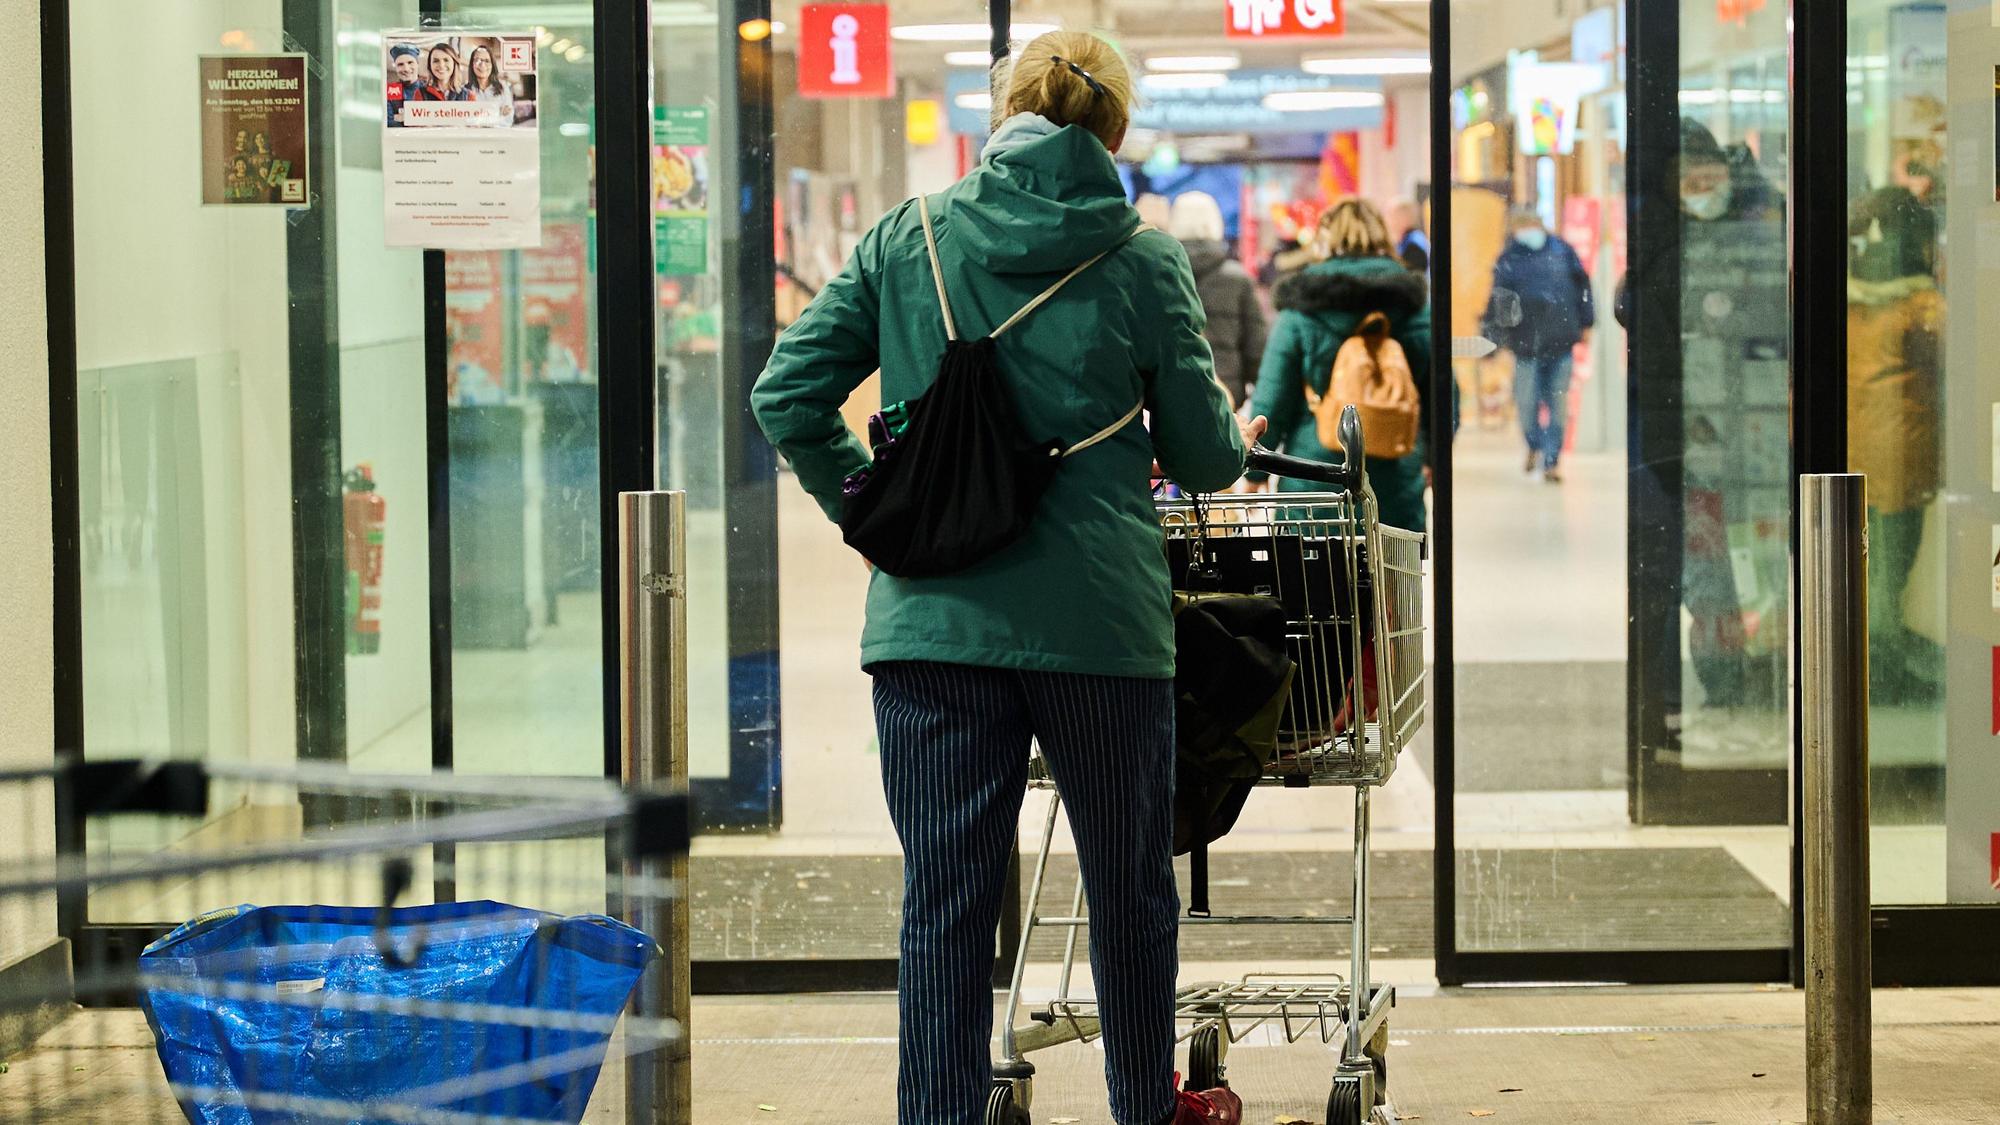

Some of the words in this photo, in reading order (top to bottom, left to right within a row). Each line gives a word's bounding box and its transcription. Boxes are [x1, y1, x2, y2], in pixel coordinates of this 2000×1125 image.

[227, 69, 278, 79] HERZLICH
[207, 78, 298, 90] WILLKOMMEN!
[411, 108, 431, 118] Wir
[434, 107, 471, 118] stellen
